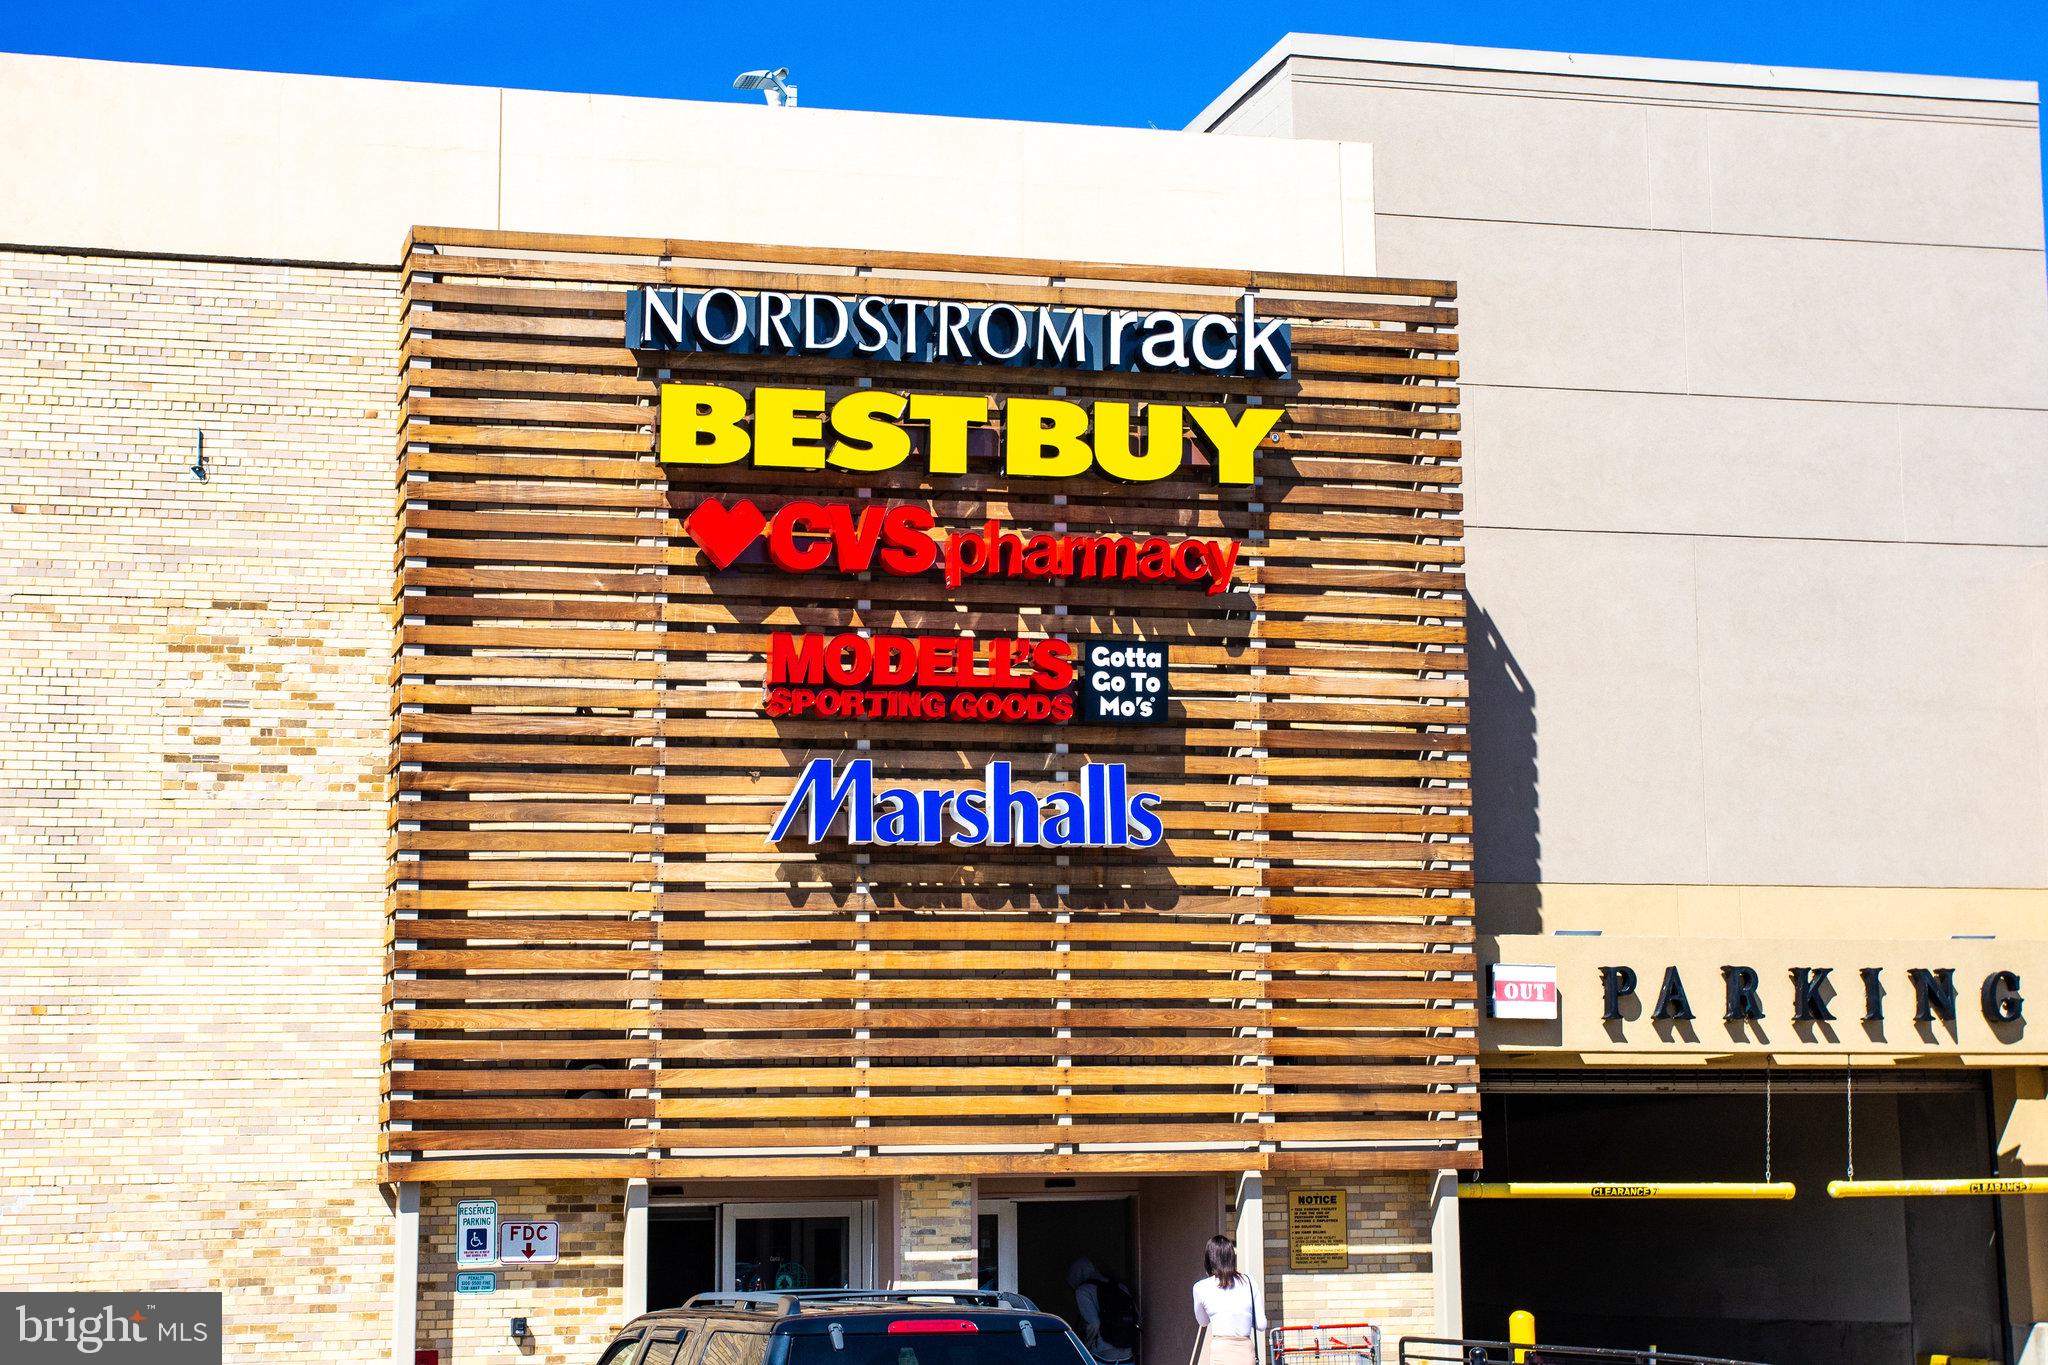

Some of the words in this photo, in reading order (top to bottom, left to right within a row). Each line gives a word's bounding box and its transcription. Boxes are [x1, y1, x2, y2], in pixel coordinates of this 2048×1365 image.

[643, 286, 1086, 363] NORDSTROM
[1109, 294, 1288, 373] rack
[659, 383, 989, 476] BEST
[1005, 397, 1287, 485] BUY
[769, 500, 938, 576] CVS
[945, 519, 1241, 597] pharmacy
[770, 631, 1074, 693] MODELL'S
[1091, 646, 1162, 668] Gotta
[1092, 670, 1126, 692] Go
[1130, 672, 1161, 693] To
[766, 687, 947, 721] SPORTING
[950, 691, 1074, 724] GOODS
[1099, 695, 1154, 717] Mo's
[765, 757, 1165, 849] Marshalls
[1504, 982, 1547, 1001] OUT
[1597, 964, 2026, 1023] PARKING
[1297, 1195, 1337, 1205] NOTICE
[1592, 1186, 1650, 1197] CLEARANCE
[459, 1206, 495, 1216] RESERVED
[462, 1217, 491, 1226] PARKING
[510, 1225, 548, 1241] FDC
